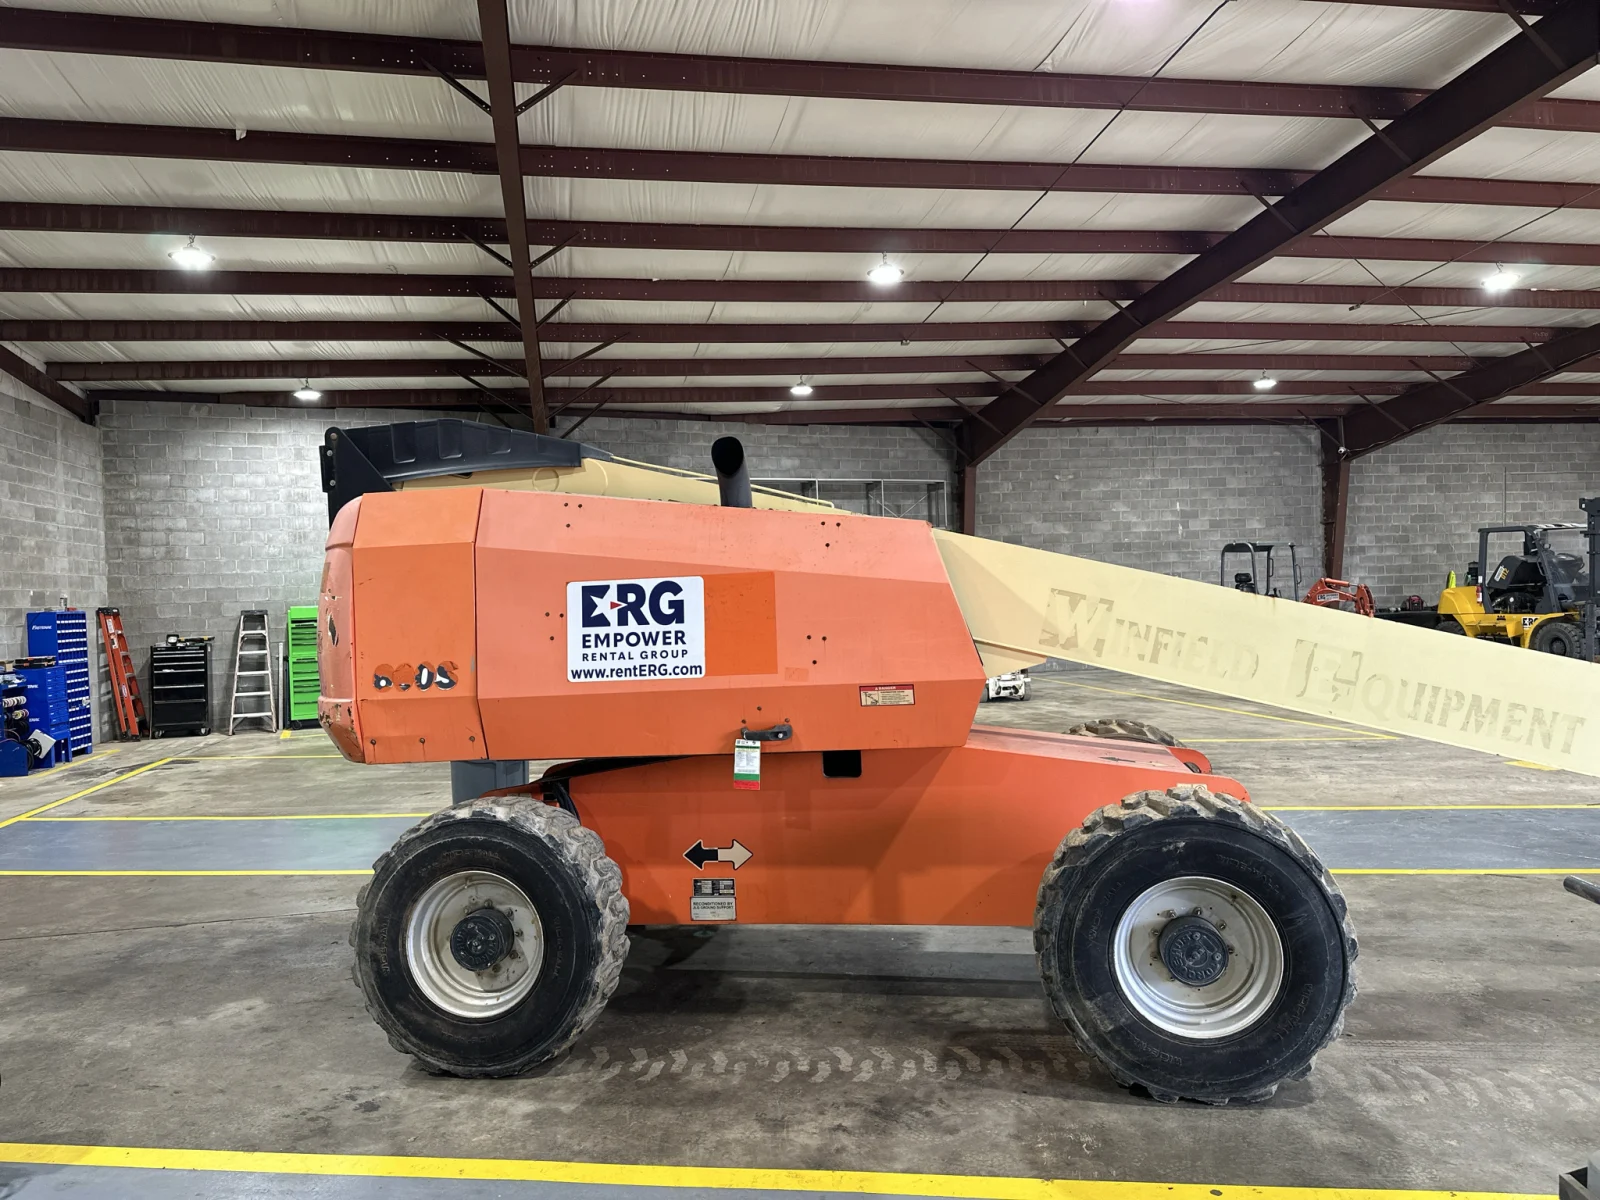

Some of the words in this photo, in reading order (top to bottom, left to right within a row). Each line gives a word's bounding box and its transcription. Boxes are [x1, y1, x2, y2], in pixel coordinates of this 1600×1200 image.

[582, 580, 685, 628] ERG
[582, 630, 686, 649] EMPOWER
[1039, 588, 1259, 682] WINFIELD
[571, 663, 703, 679] www.rentERG.com
[582, 651, 634, 662] RENTAL
[639, 649, 688, 660] GROUP
[1285, 638, 1587, 755] EQUIPMENT
